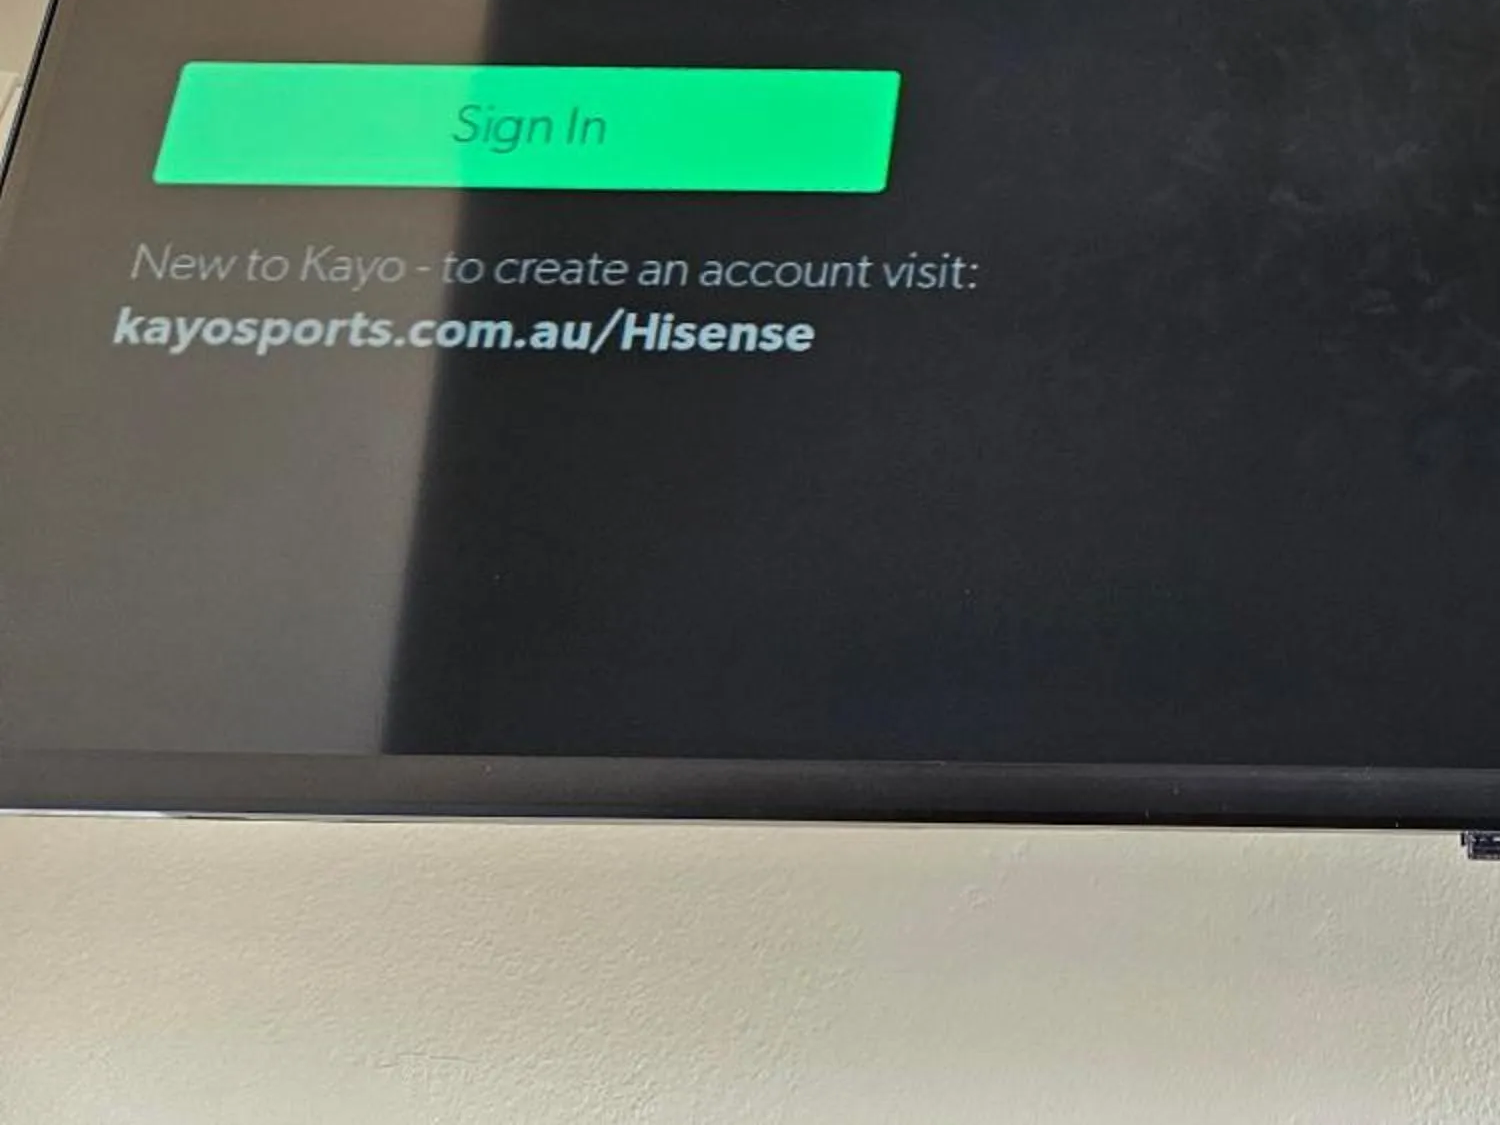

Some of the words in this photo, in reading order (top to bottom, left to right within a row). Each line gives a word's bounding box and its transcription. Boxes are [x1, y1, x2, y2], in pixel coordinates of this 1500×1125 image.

[452, 104, 554, 154] Sign
[566, 106, 607, 145] In
[130, 242, 239, 282] New
[247, 248, 290, 283] to
[300, 245, 406, 293] Kayo
[441, 250, 484, 284] to
[493, 252, 629, 286] create
[637, 257, 688, 287] an
[698, 254, 874, 288] account
[882, 251, 980, 290] visit:
[112, 306, 816, 356] kayosports.com.au/Hisense
